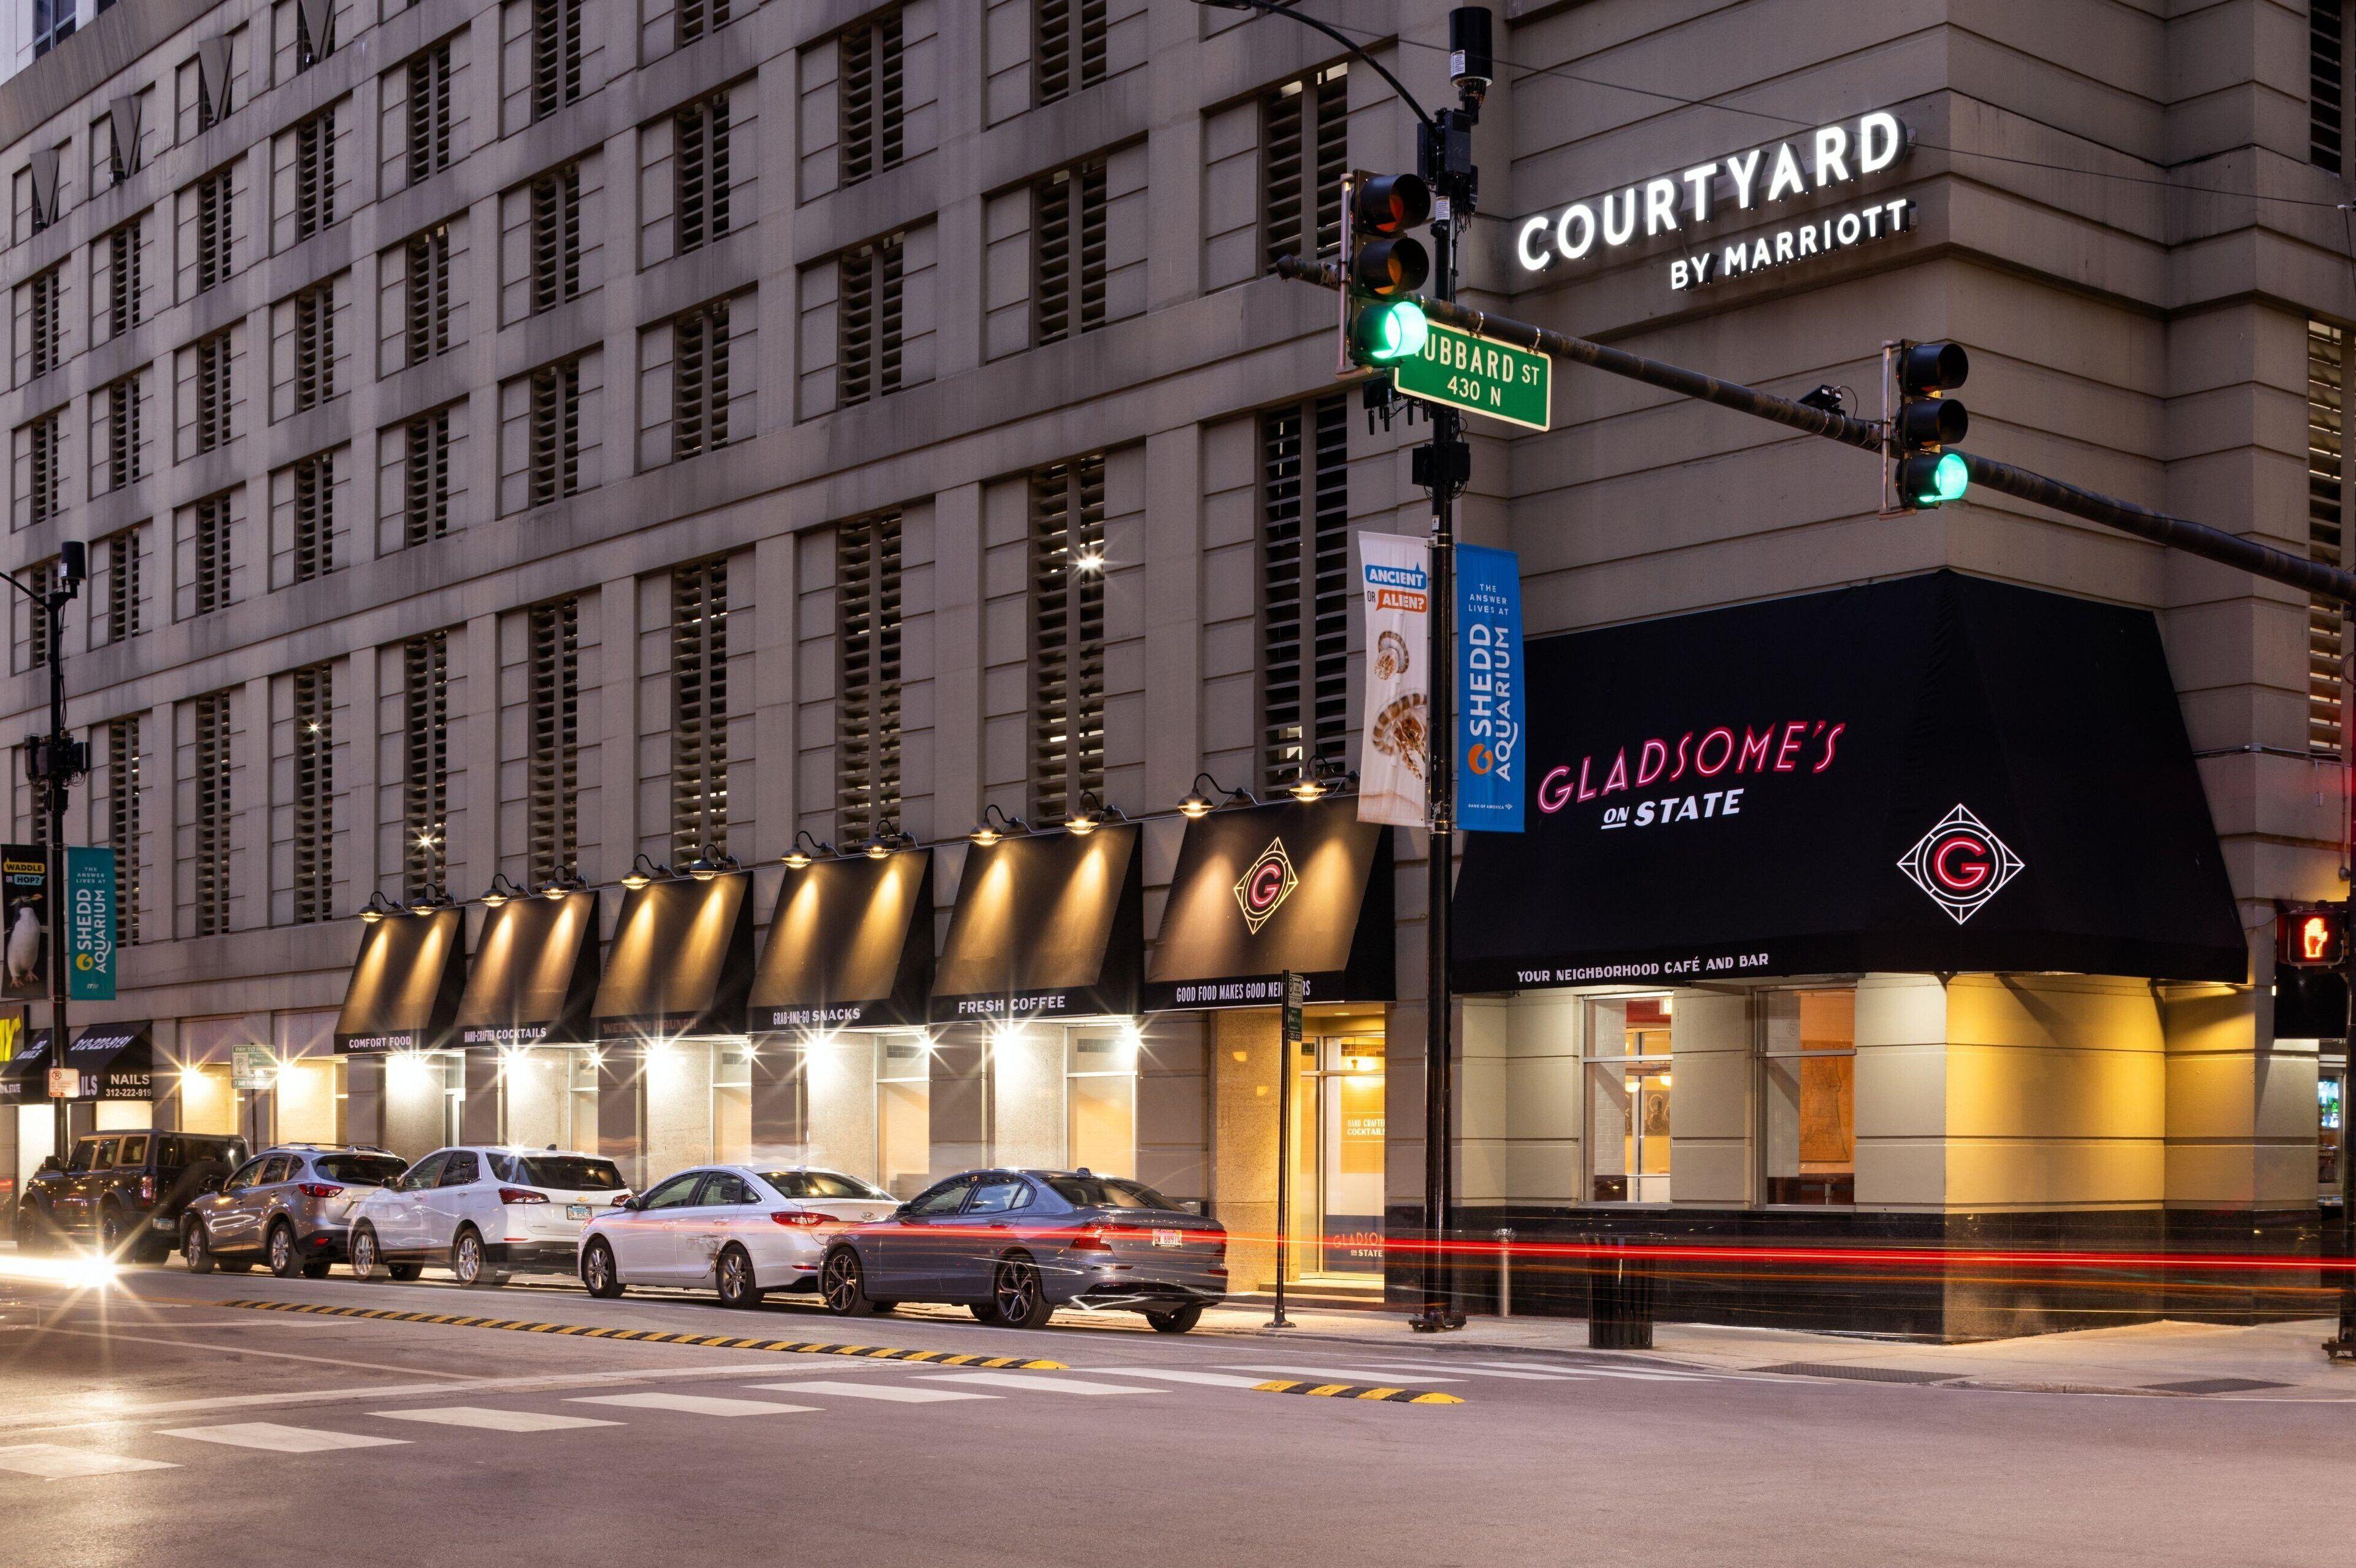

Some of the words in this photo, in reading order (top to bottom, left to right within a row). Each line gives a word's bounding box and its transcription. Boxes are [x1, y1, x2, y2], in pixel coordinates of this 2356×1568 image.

[1517, 112, 1900, 271] COURTYARD
[1671, 252, 1712, 290] BY
[1724, 198, 1908, 277] MARRIOTT
[1415, 332, 1514, 383] UBBARD
[1522, 364, 1539, 386] ST
[1447, 375, 1480, 401] 430
[1490, 386, 1501, 407] N
[1369, 567, 1424, 588] ANCIENT
[1479, 583, 1497, 593] THE
[1367, 590, 1376, 603] OR
[1382, 593, 1425, 610] ALIEN?
[1468, 604, 1495, 614] LIVES
[1498, 607, 1509, 616] AT
[1469, 593, 1507, 605] ANSWER
[1469, 622, 1492, 737] SHEDD
[1495, 628, 1518, 782] AQUARIUM
[1537, 720, 1846, 814] GLADSOME'S
[1602, 805, 1630, 828] ON
[1634, 788, 1744, 827] STATE
[6, 864, 43, 872] WADDLE
[1933, 836, 1990, 891] G
[1250, 864, 1282, 907] G
[76, 889, 92, 950] SHEDD
[93, 890, 112, 974] AQUARIUM
[1517, 969, 1550, 982] YOUR
[1556, 962, 1660, 981] NEIGHBORHOOD
[1664, 956, 1701, 974] CAFÉ
[1706, 955, 1734, 970] AND
[1739, 953, 1769, 967] BAR
[1176, 986, 1196, 1002] GOOD
[1198, 985, 1217, 1001] FOOD
[1219, 983, 1244, 1000] MAKES
[1245, 982, 1266, 999] GOOD
[812, 1007, 861, 1021] SNACKS
[958, 999, 1004, 1014] FRESH
[1010, 996, 1065, 1010] COFFEE
[349, 1037, 386, 1048] COMFORT
[389, 1036, 411, 1047] FOOD
[464, 1029, 495, 1043] HAND-CRAFTED
[496, 1028, 547, 1040] COCKTAILS
[80, 1075, 98, 1096] ILS
[110, 1074, 150, 1085] NAILS
